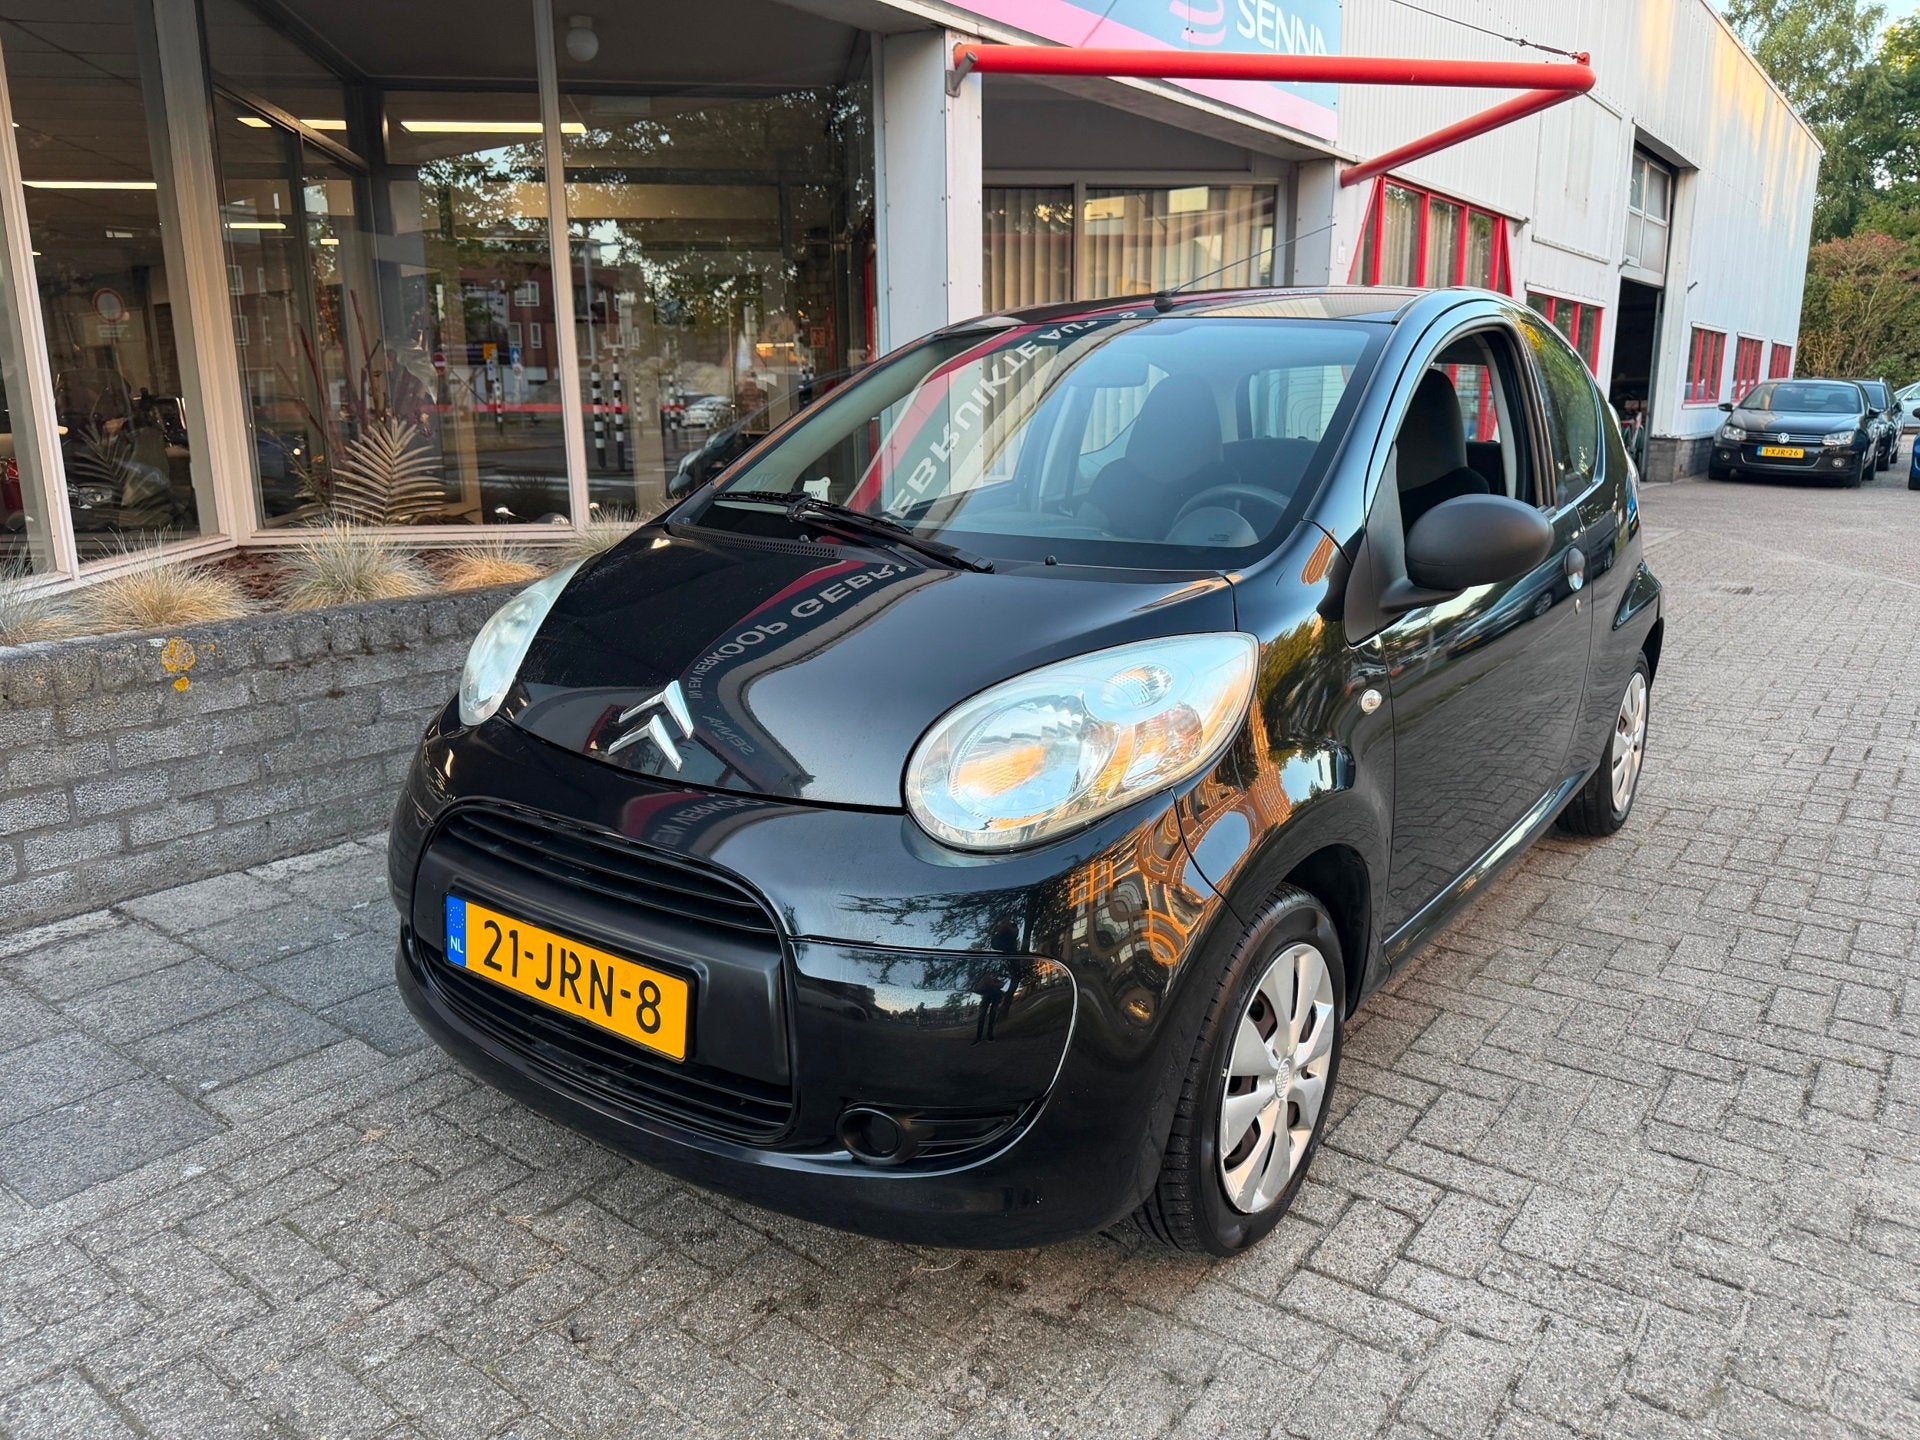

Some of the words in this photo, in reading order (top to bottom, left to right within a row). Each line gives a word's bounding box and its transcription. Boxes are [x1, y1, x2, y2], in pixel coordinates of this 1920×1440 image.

[1236, 0, 1328, 56] SENNA
[450, 935, 464, 954] NL
[483, 920, 662, 1035] 21-JRN-8
